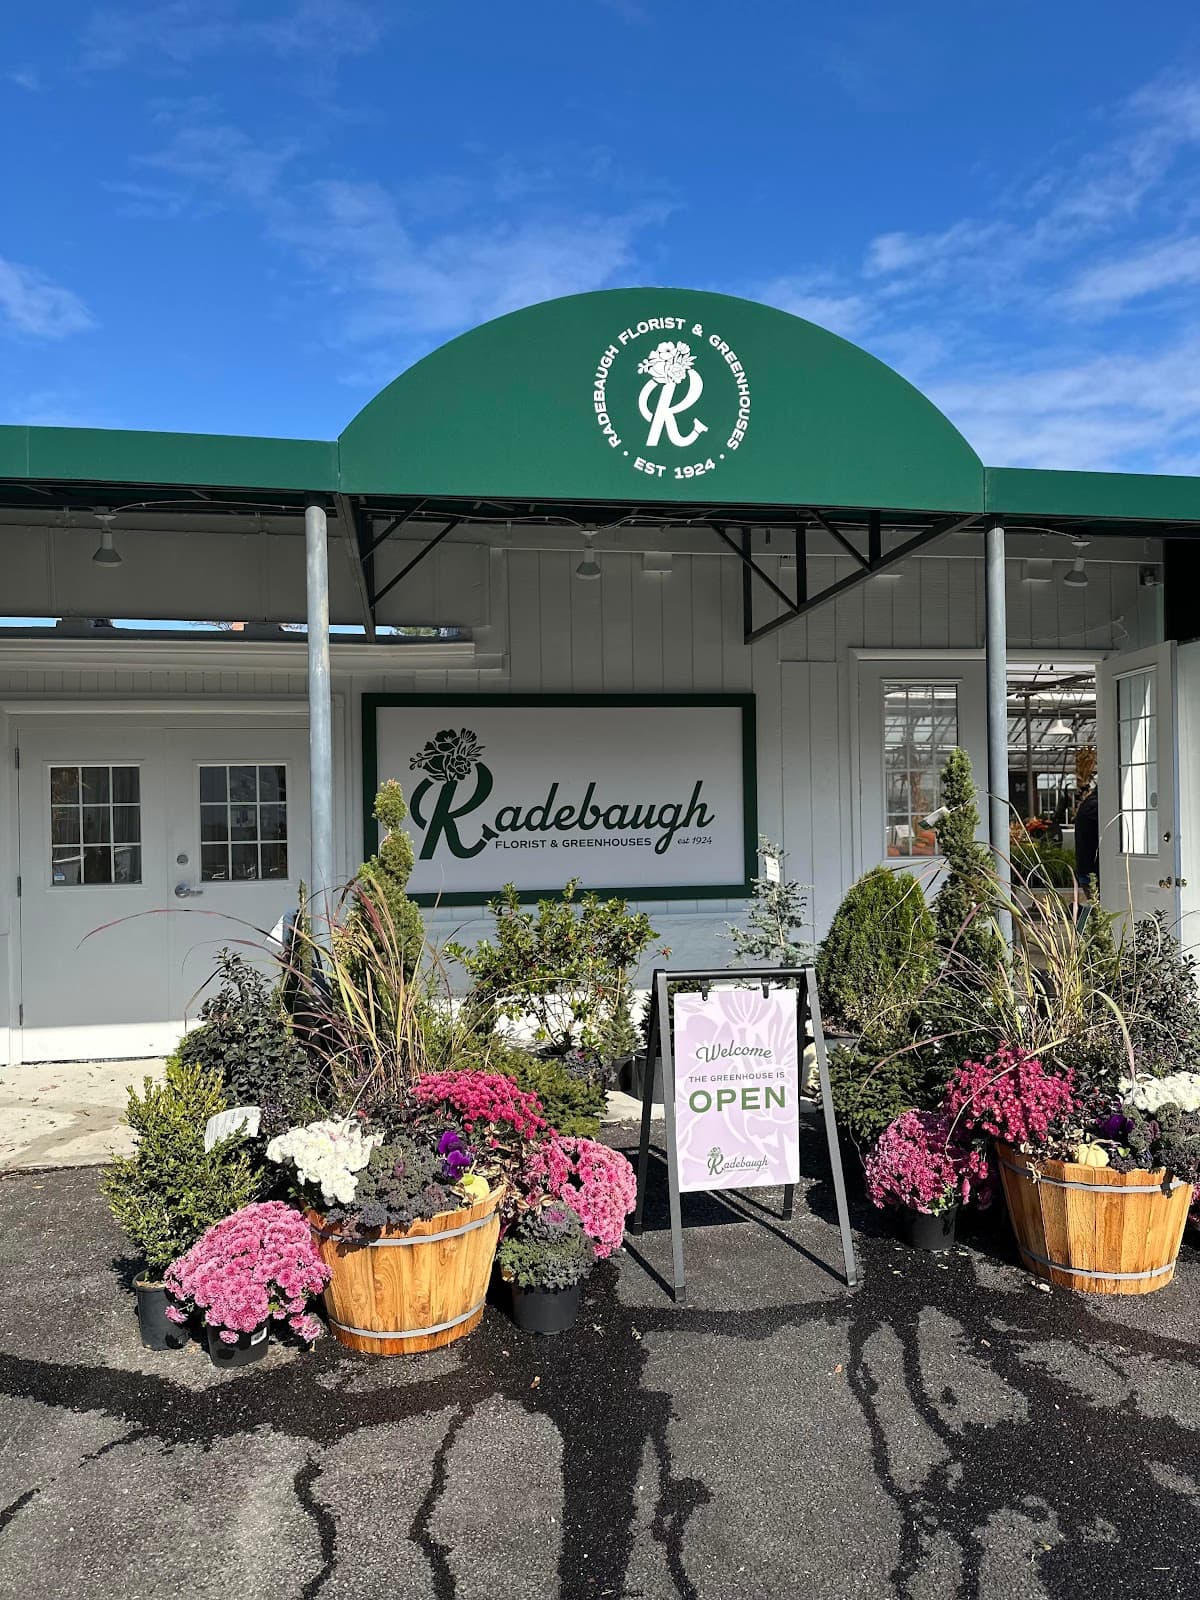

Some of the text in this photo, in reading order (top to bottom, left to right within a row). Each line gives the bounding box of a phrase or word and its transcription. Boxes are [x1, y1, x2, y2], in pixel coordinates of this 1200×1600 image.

[593, 317, 751, 450] RADEBAUGH FLORIST & GREENHOUSES
[633, 456, 716, 479] EST 1924
[409, 761, 716, 860] Radebaugh
[494, 837, 652, 849] FLORIST & GREENHOUSES
[692, 835, 713, 846] 1924
[695, 1039, 774, 1063] Welcome
[688, 1071, 786, 1083] THE GREENHOUSE IS
[688, 1085, 786, 1114] OPEN
[707, 1153, 769, 1176] Radebaugh
